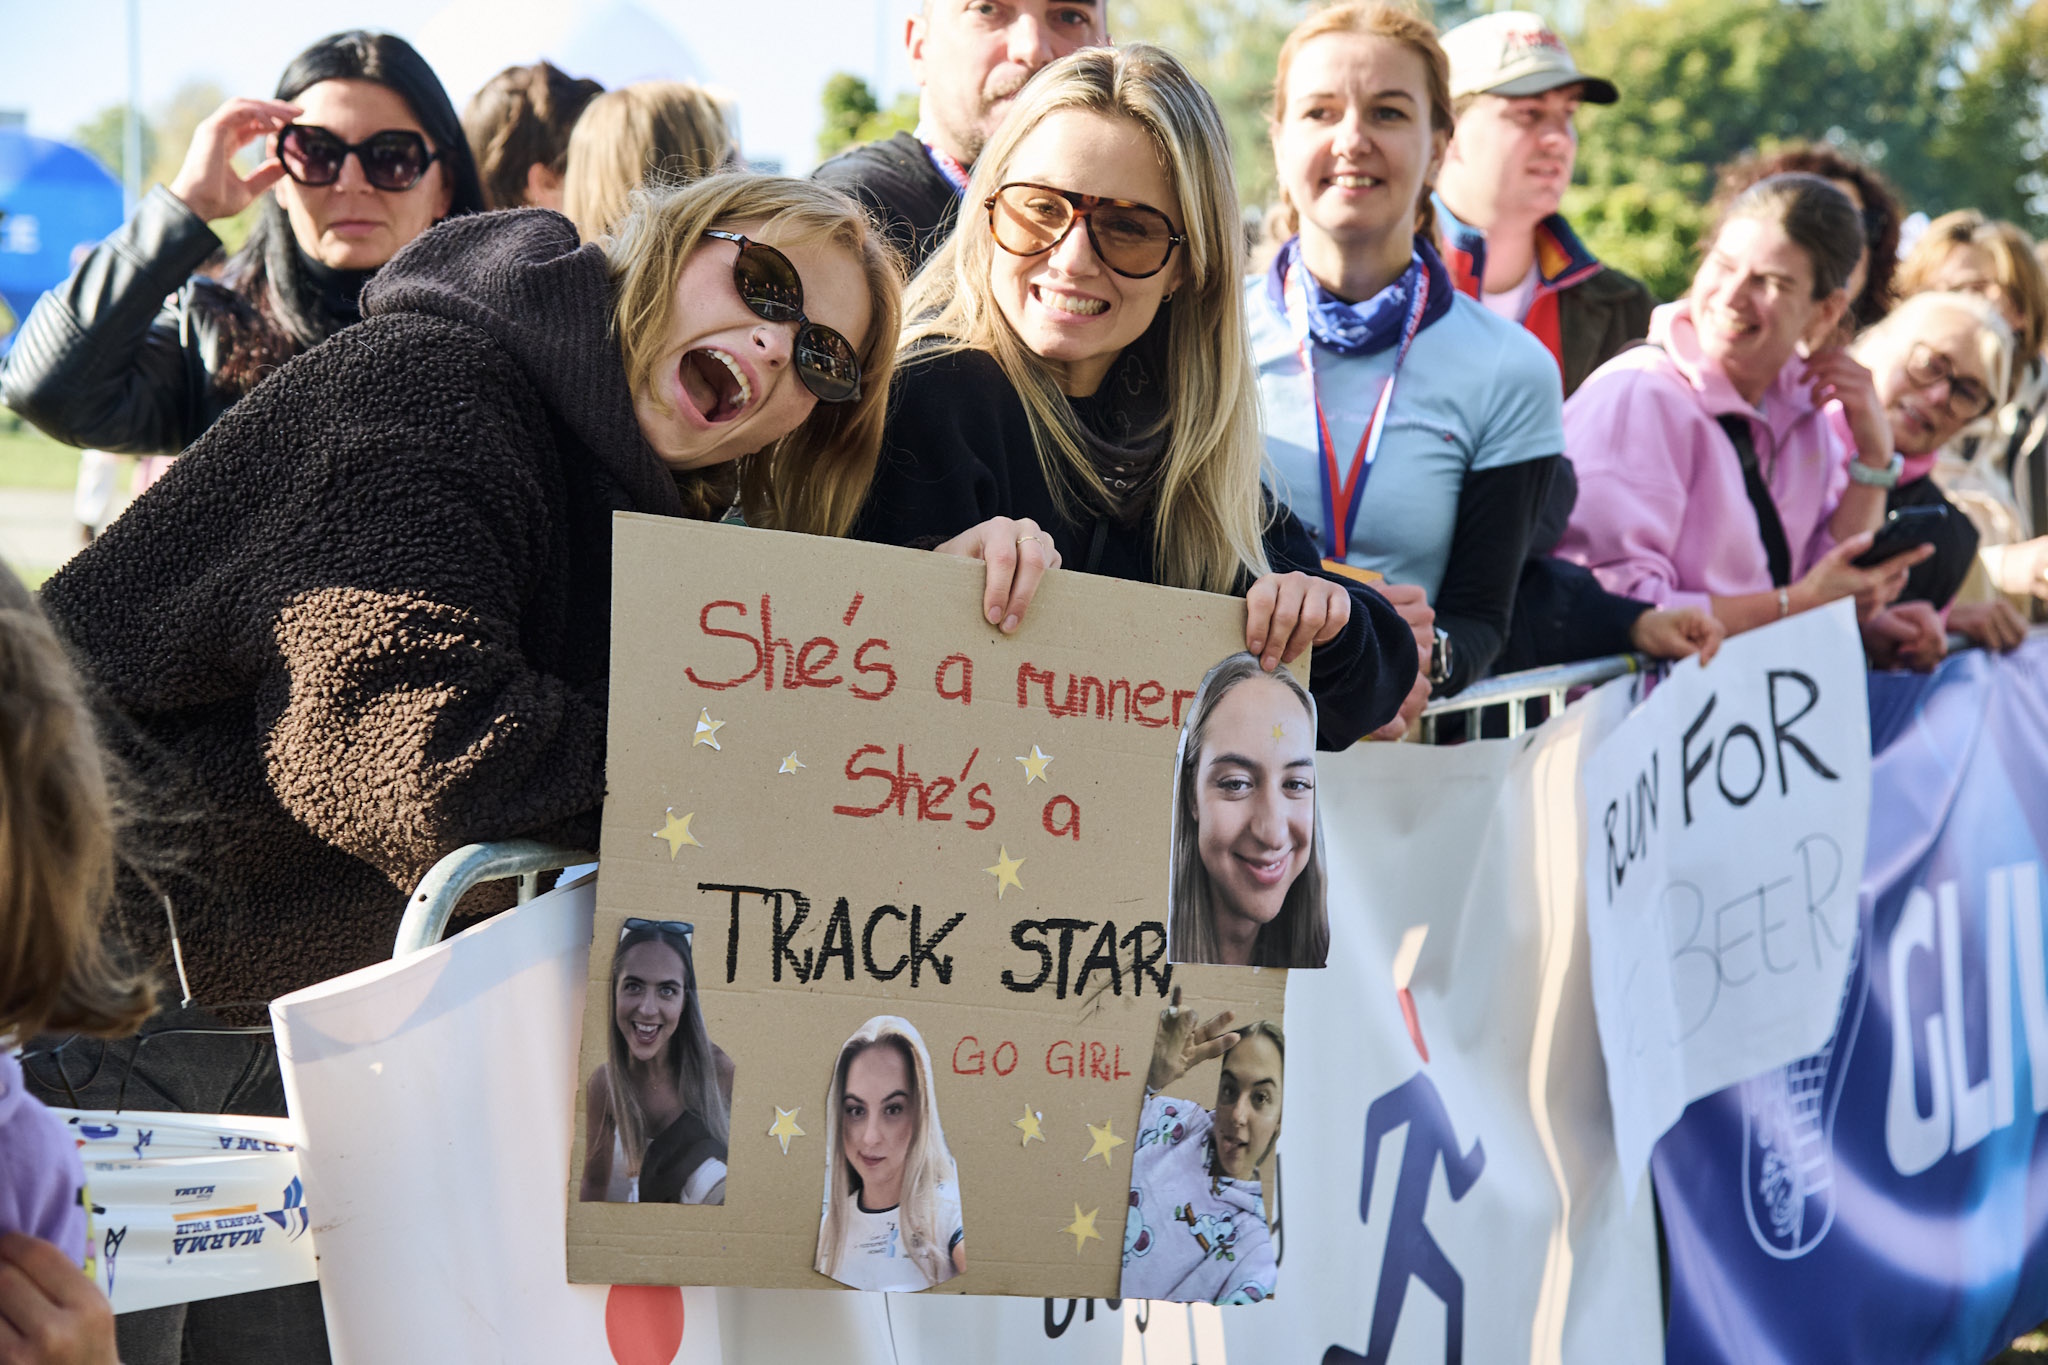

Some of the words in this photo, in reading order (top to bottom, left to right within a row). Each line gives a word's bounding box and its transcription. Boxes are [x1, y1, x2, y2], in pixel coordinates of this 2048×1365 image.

[684, 592, 898, 701] She's
[936, 653, 973, 705] a
[1017, 662, 1195, 730] runner
[833, 744, 996, 831] She's
[1042, 795, 1081, 841] a
[1603, 750, 1659, 906] RUN
[1681, 670, 1840, 828] FOR
[697, 882, 967, 988] TRACK
[1000, 918, 1173, 1000] STAR
[1660, 832, 1847, 1050] BEER
[952, 1035, 1018, 1077] GO
[1045, 1040, 1131, 1082] GIRL
[172, 1227, 266, 1256] MARMA
